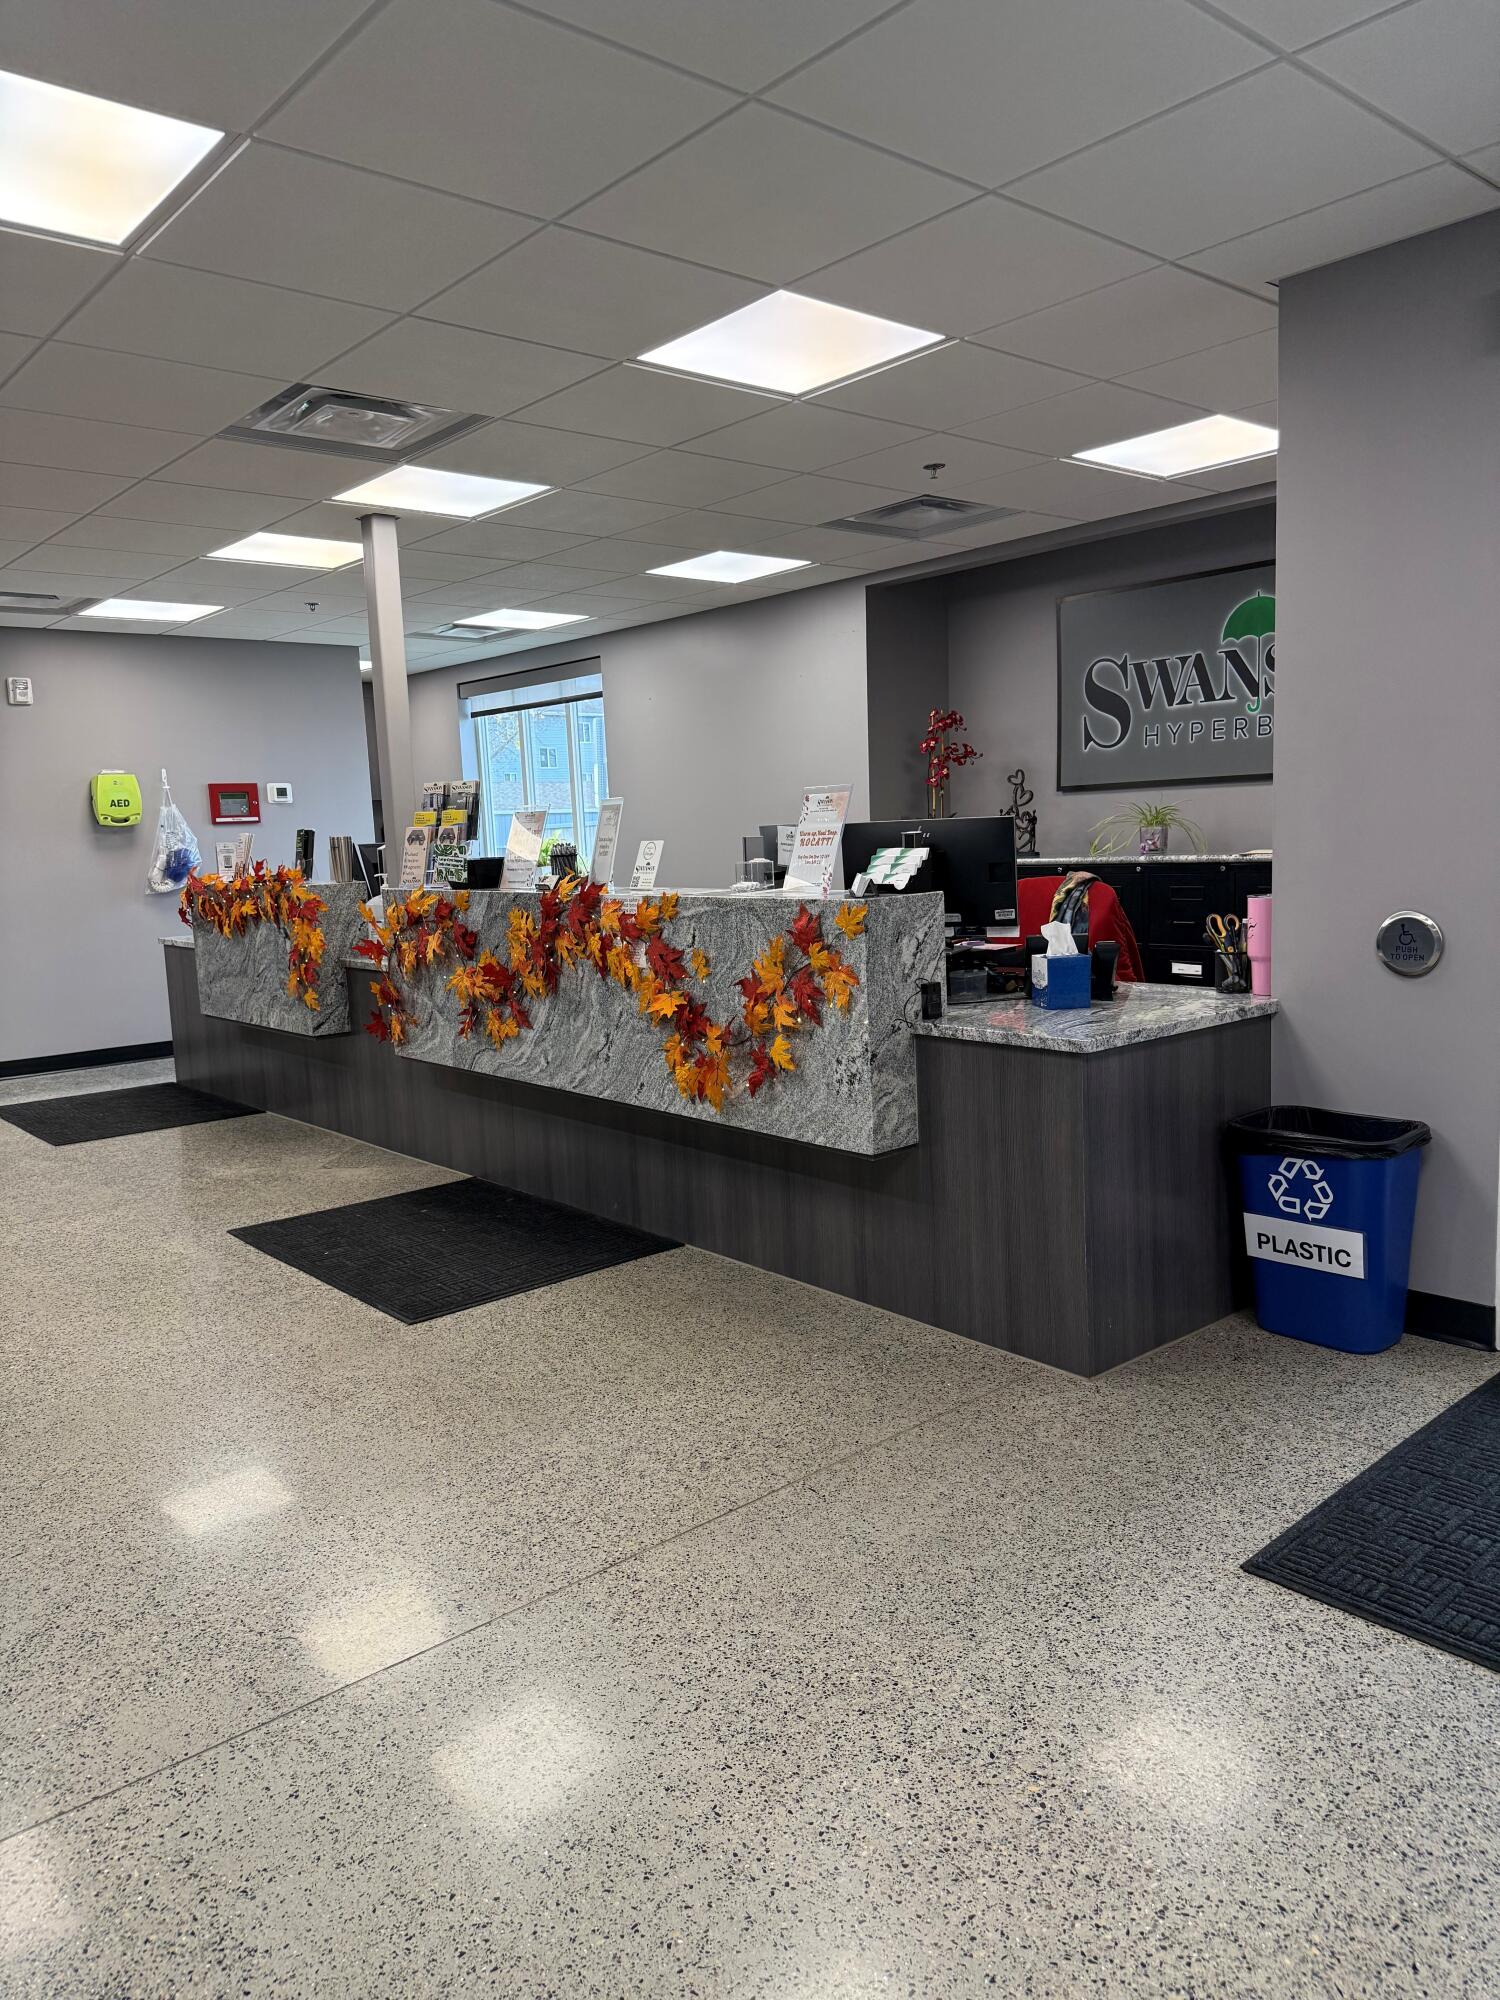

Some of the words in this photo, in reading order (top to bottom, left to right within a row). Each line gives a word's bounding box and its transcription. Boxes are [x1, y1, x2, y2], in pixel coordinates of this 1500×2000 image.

[109, 799, 130, 808] AED
[1395, 945, 1418, 954] PUSH
[1402, 953, 1425, 961] OPEN
[1256, 1231, 1352, 1268] PLASTIC
